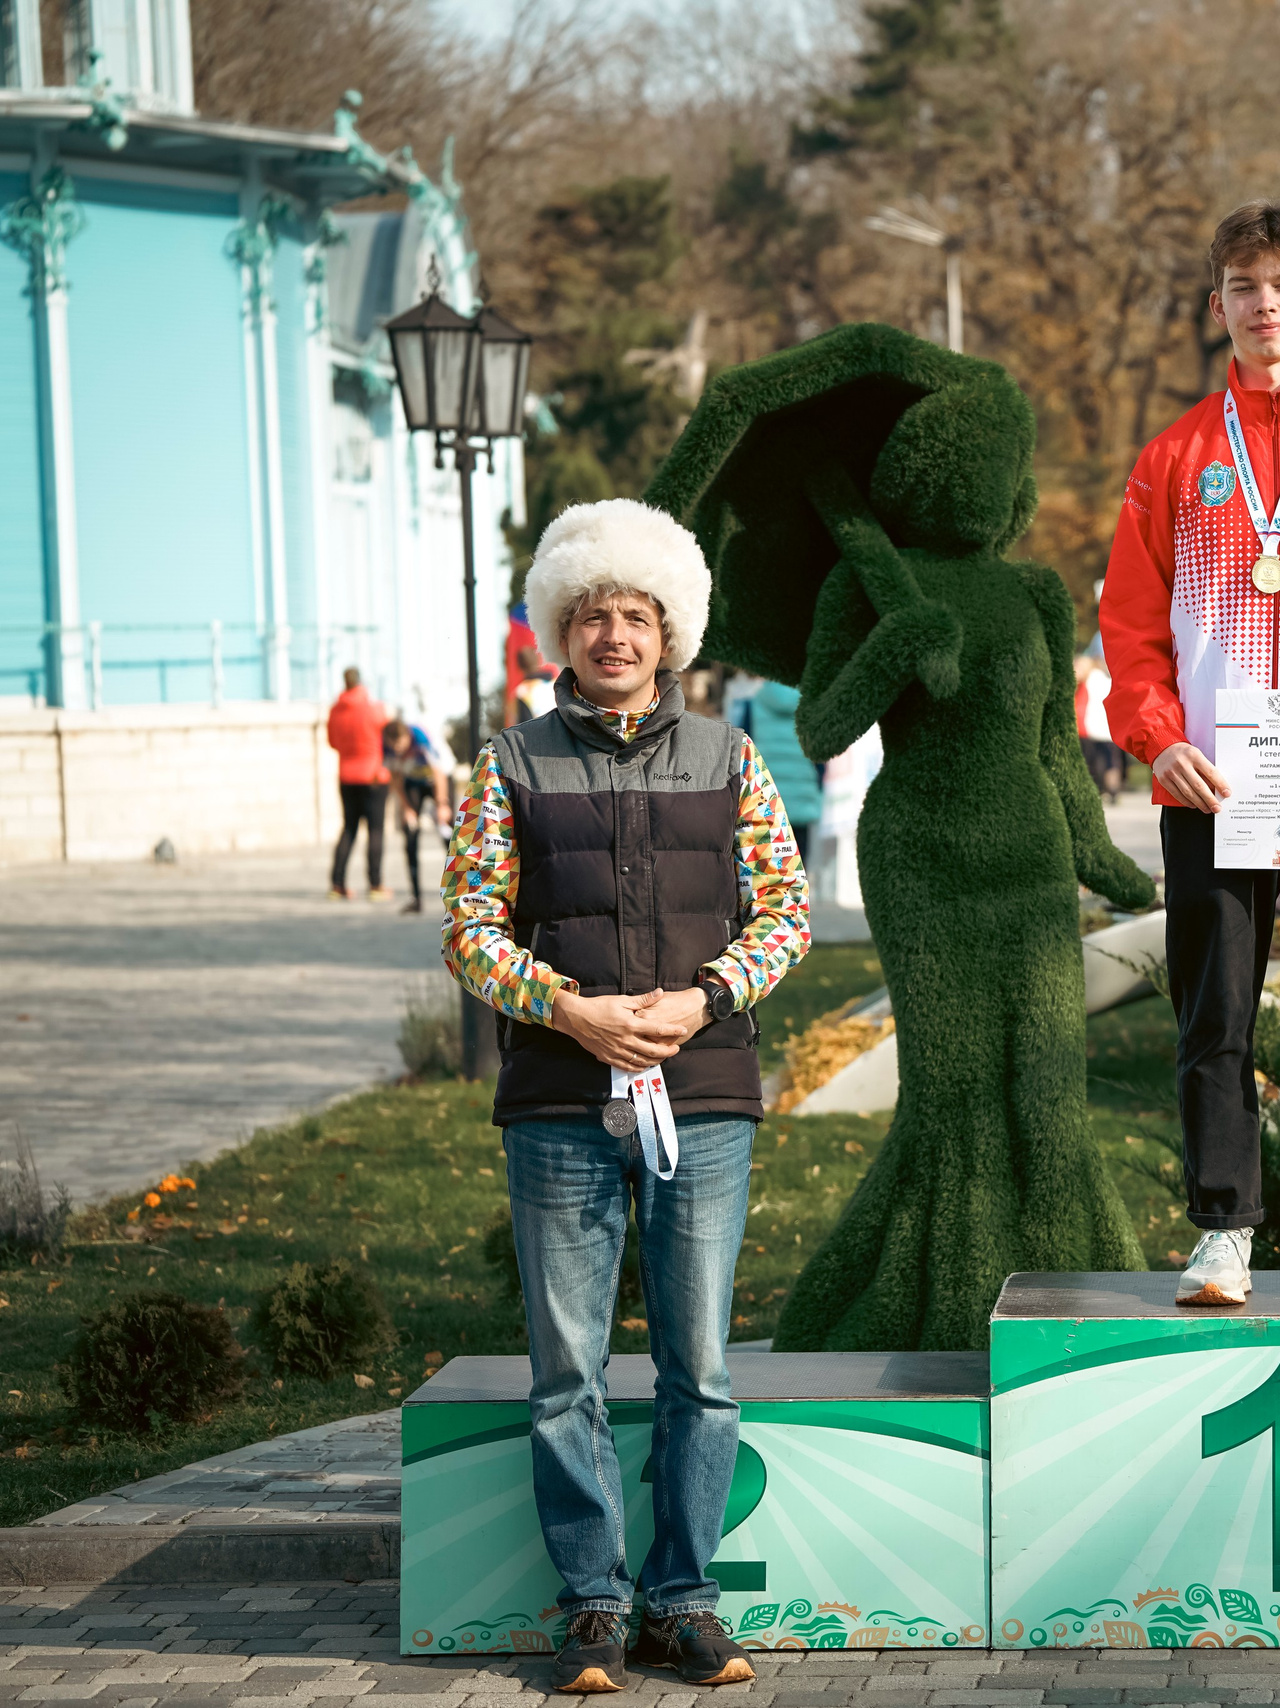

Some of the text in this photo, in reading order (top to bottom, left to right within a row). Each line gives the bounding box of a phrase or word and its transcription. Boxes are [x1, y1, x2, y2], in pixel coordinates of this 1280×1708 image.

[1229, 420, 1258, 511] МИНИСТЕРСТВО СПОРТА РОССИИ
